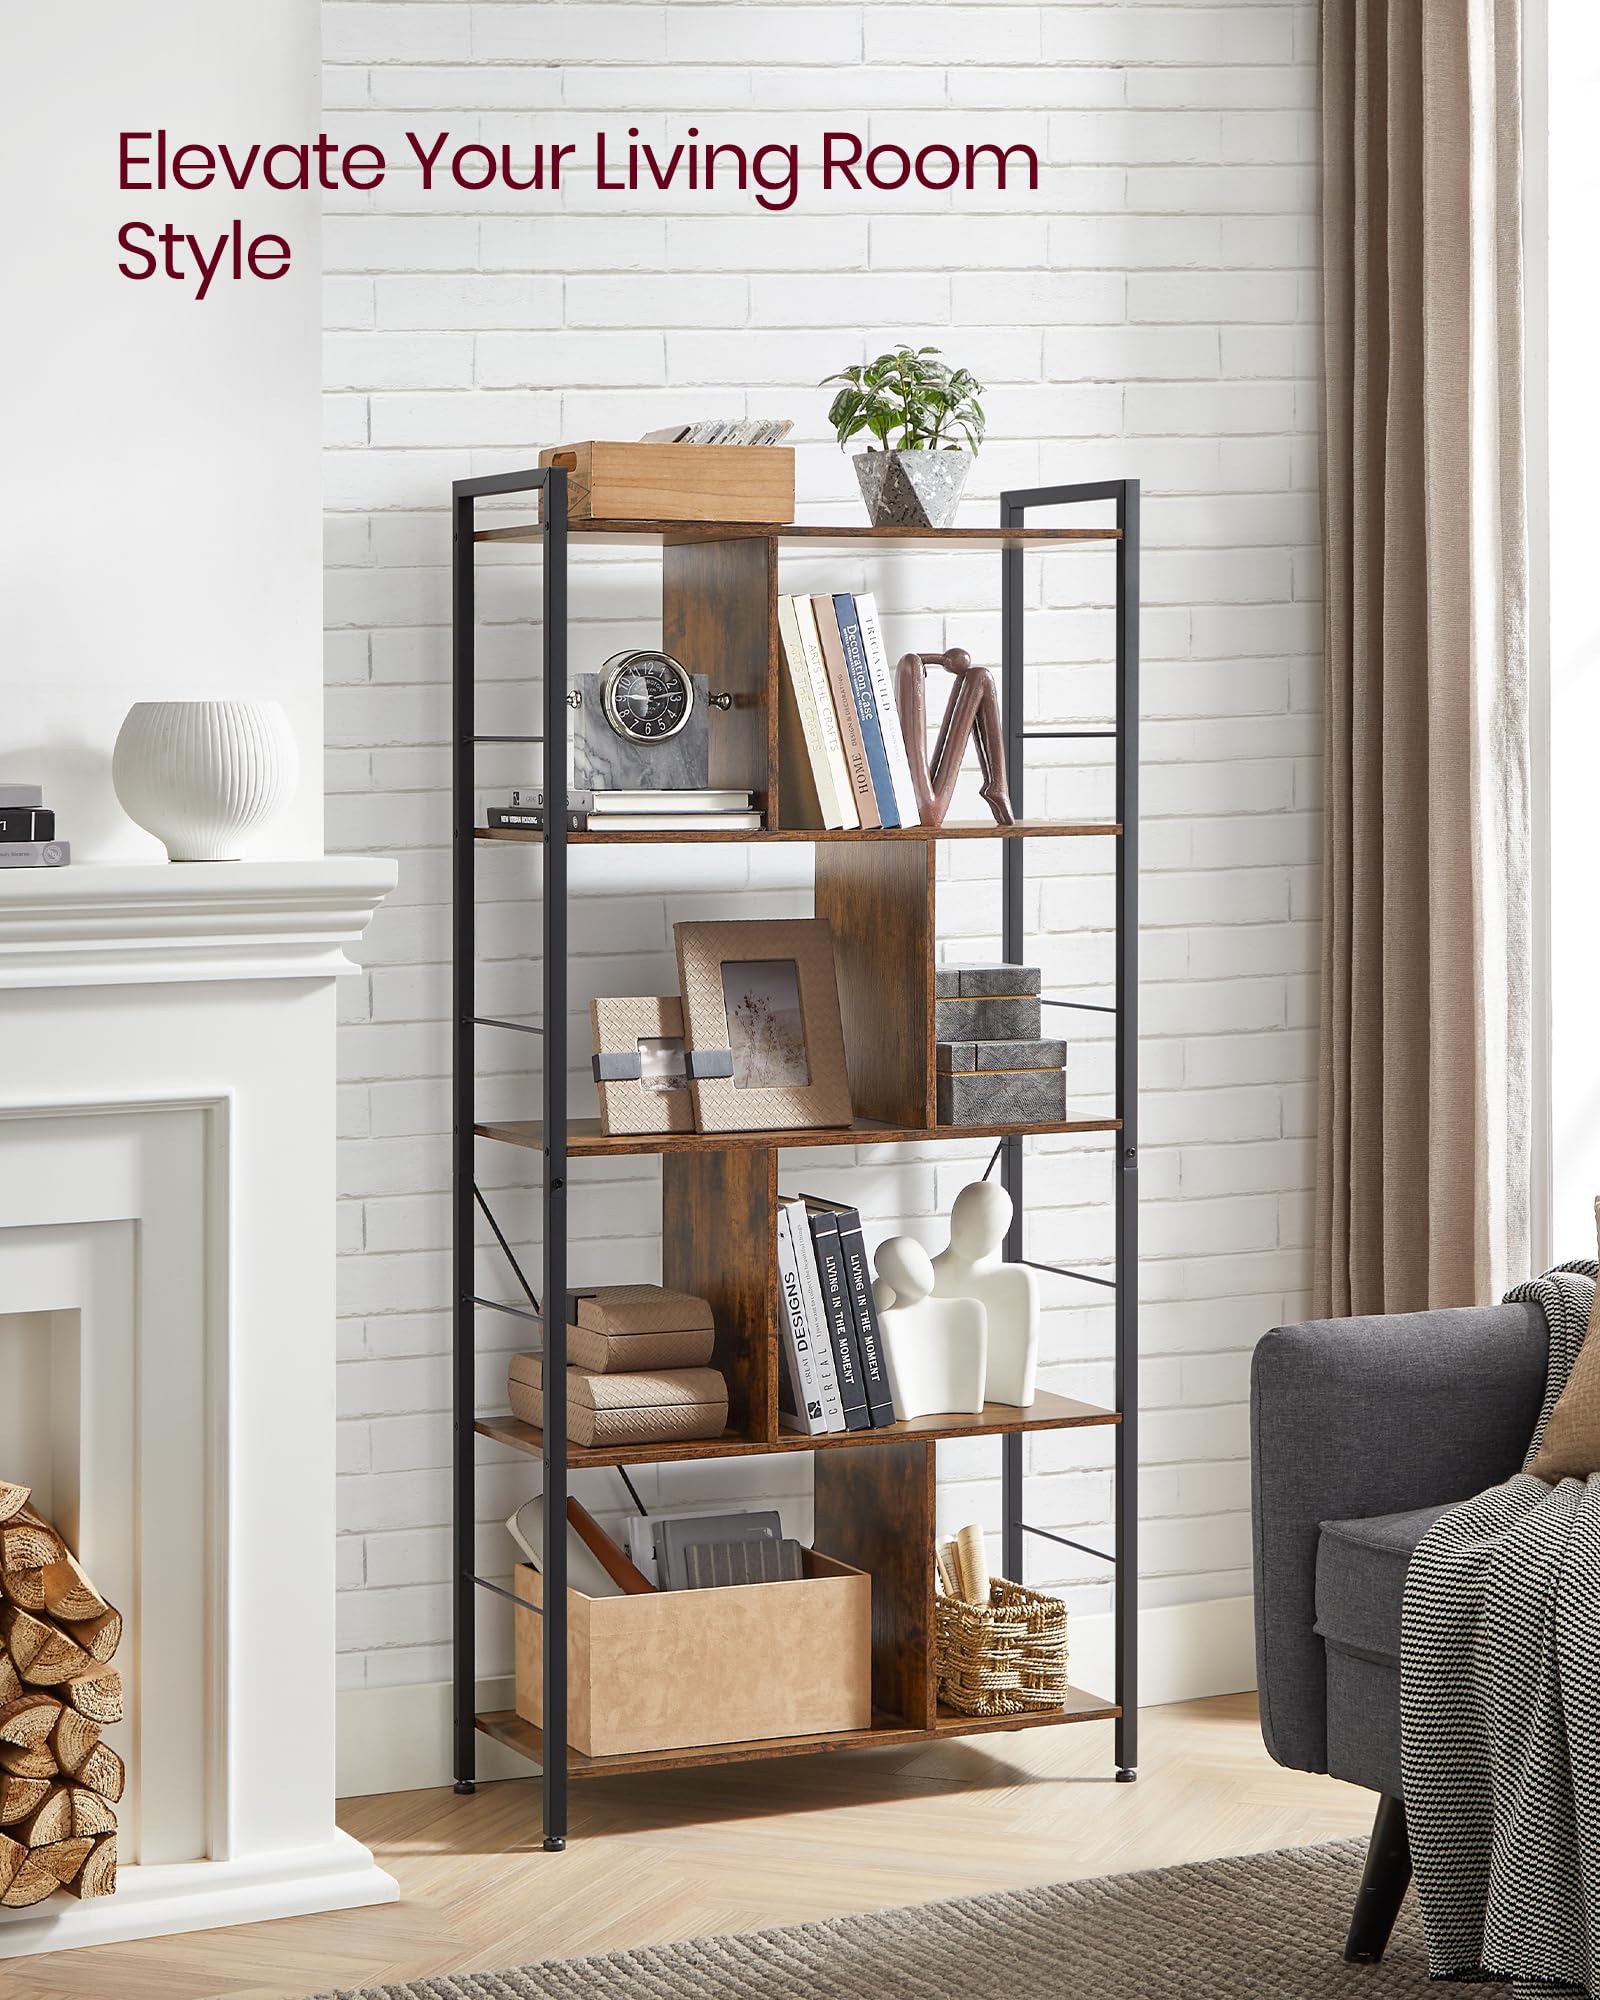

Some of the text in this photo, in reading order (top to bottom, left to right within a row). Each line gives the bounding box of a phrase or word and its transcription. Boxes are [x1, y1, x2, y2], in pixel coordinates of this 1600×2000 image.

[629, 667, 641, 679] 11
[643, 662, 654, 675] 12
[659, 667, 666, 678] 1
[846, 623, 870, 689] Decoration
[860, 690, 876, 720] Case
[618, 677, 631, 690] 10
[666, 678, 678, 689] 2
[836, 673, 850, 715] DECORATING
[807, 644, 838, 752] ARTS THE CRAFTS
[619, 709, 630, 718] 8
[629, 719, 640, 729] 7
[657, 718, 666, 731] 5
[667, 709, 678, 719] 4
[645, 722, 652, 735] 6
[847, 722, 857, 746] DESIGN
[851, 752, 868, 794] HOME
[825, 1255, 838, 1292] LIVING
[850, 1253, 864, 1291] LIVING
[784, 1271, 808, 1352] DESIGNS
[834, 1311, 845, 1334] THE
[859, 1309, 871, 1332] THE
[838, 1337, 854, 1383] MOMENT
[864, 1335, 880, 1381] MOMENT
[817, 1347, 837, 1415] CEREAL
